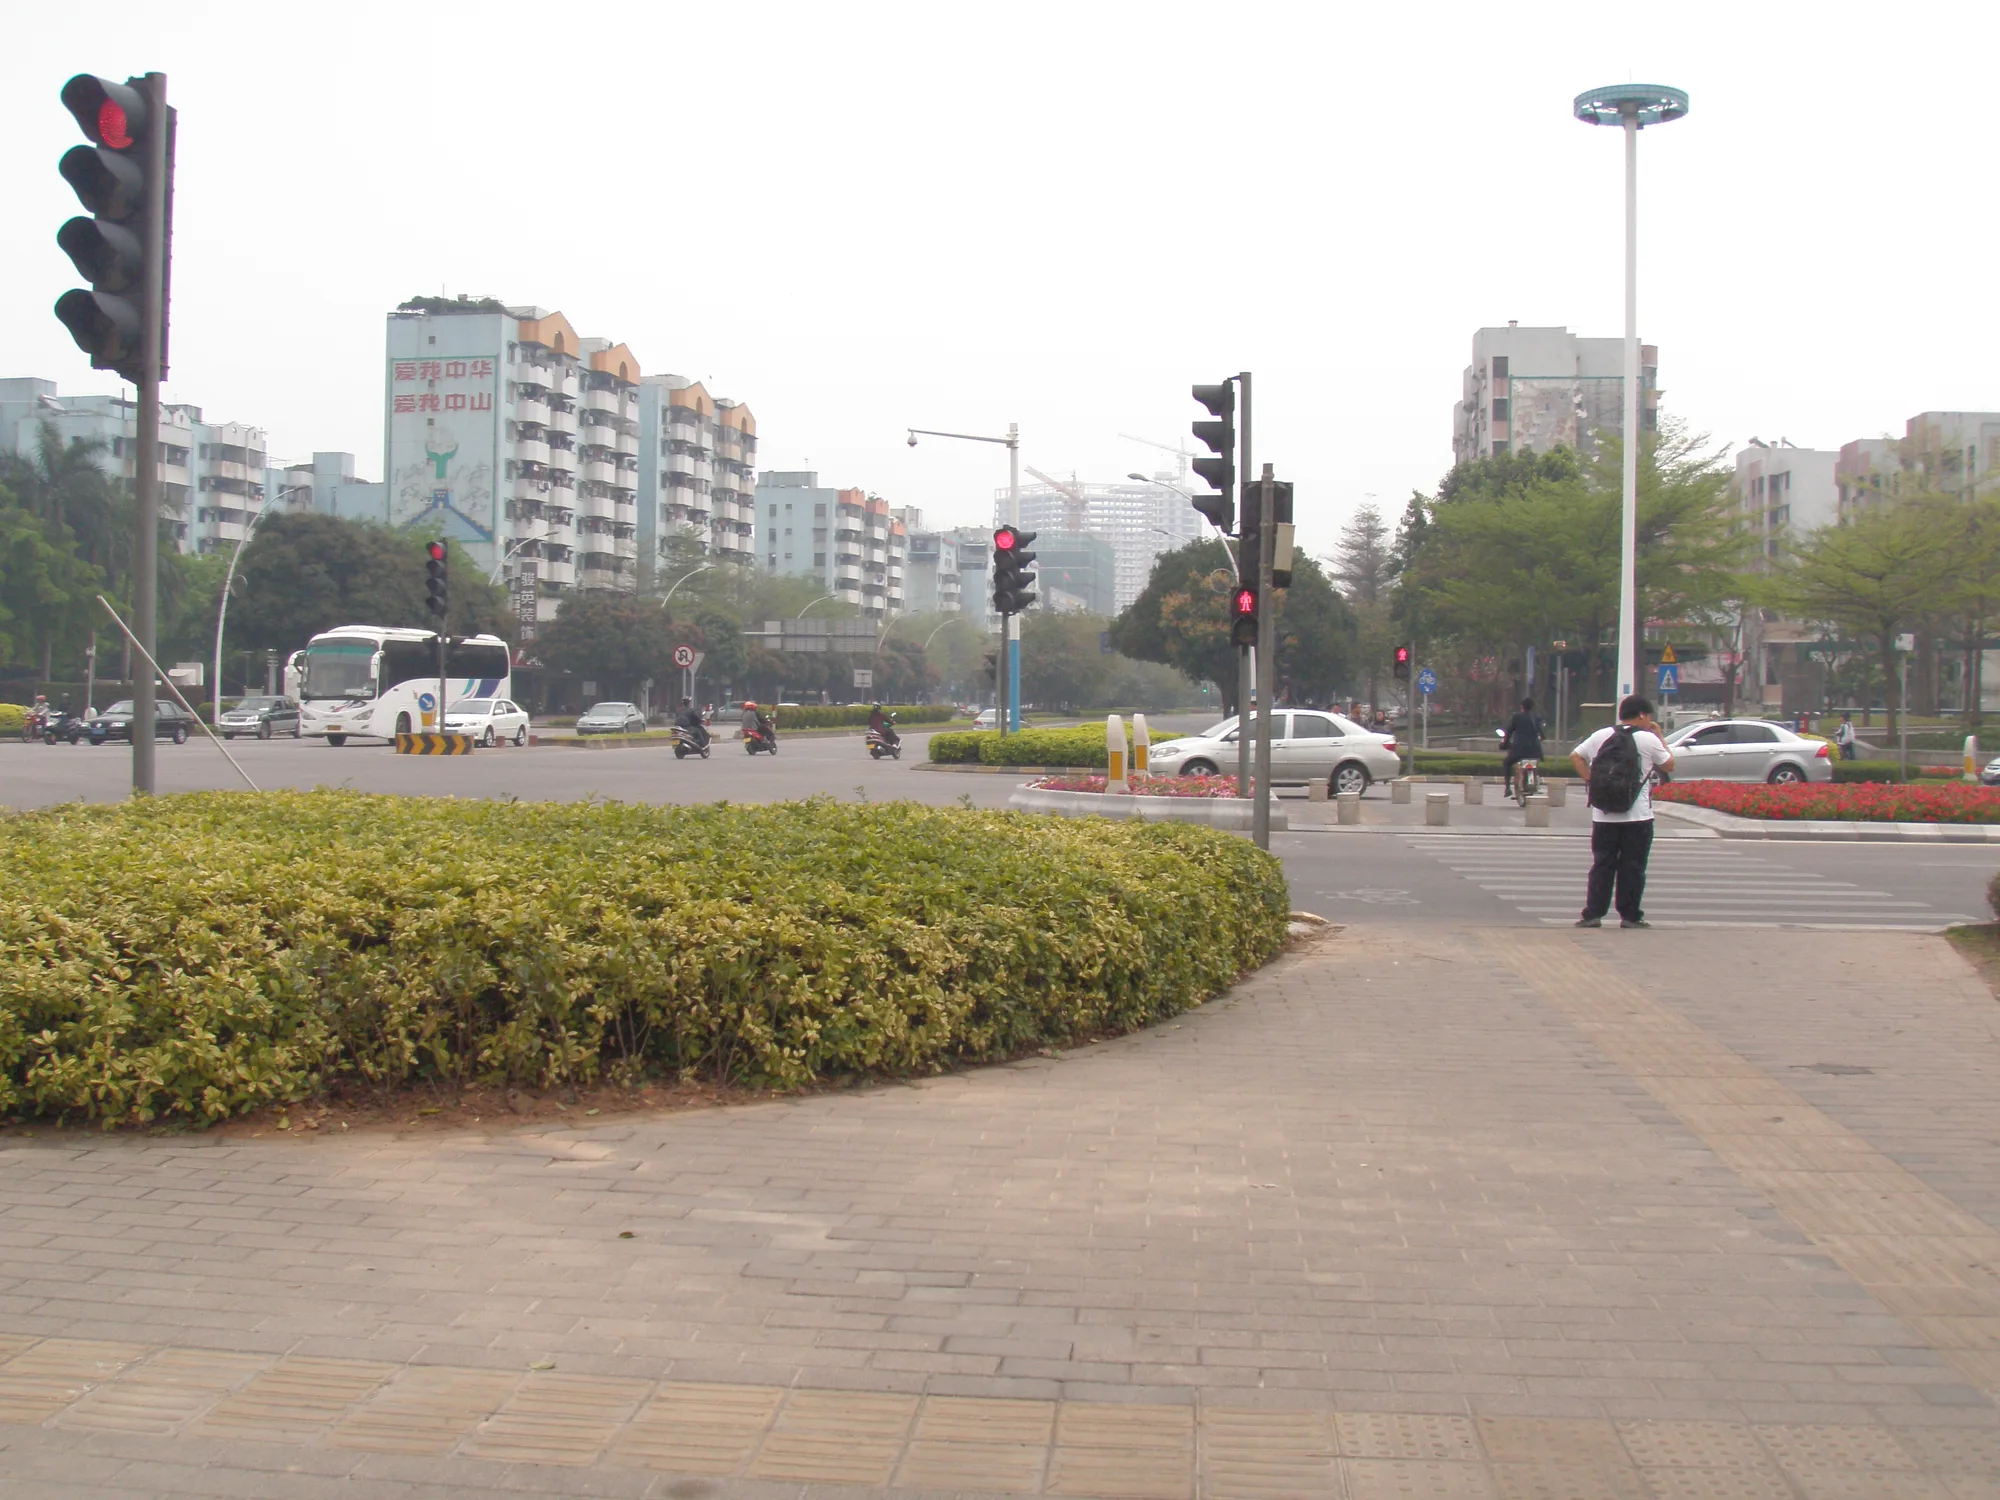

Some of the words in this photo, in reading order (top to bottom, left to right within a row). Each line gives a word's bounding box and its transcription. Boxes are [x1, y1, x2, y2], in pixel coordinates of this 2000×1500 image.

[394, 360, 492, 380] 爱我中华
[394, 392, 492, 413] 爱我中山
